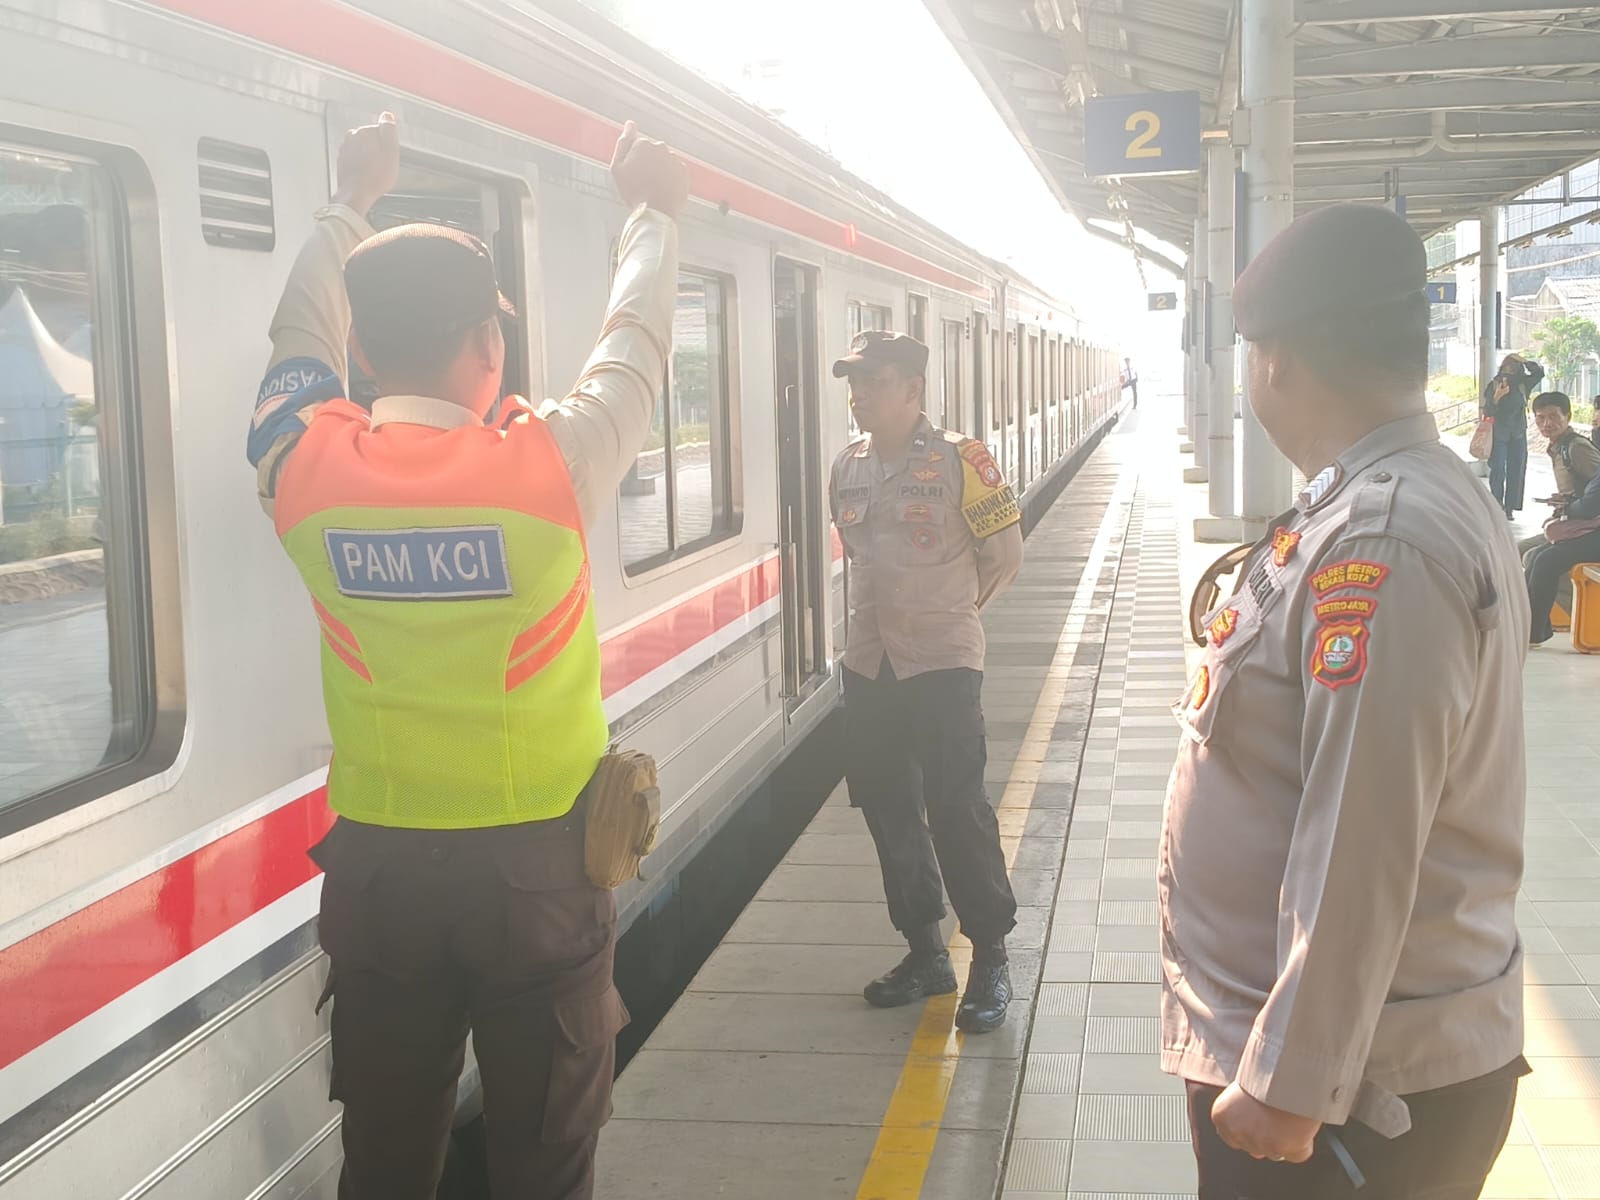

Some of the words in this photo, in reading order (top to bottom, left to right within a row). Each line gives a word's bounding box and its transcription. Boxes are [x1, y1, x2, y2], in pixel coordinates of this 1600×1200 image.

[1125, 111, 1162, 158] 2
[1436, 286, 1444, 300] 1
[1156, 295, 1167, 309] 2
[901, 485, 943, 497] POLRI
[342, 542, 414, 583] PAM
[427, 540, 490, 582] KCI
[1312, 566, 1345, 588] POLRES
[1347, 563, 1381, 577] METRO
[1346, 573, 1370, 582] KOTA
[1348, 600, 1369, 611] JAYA
